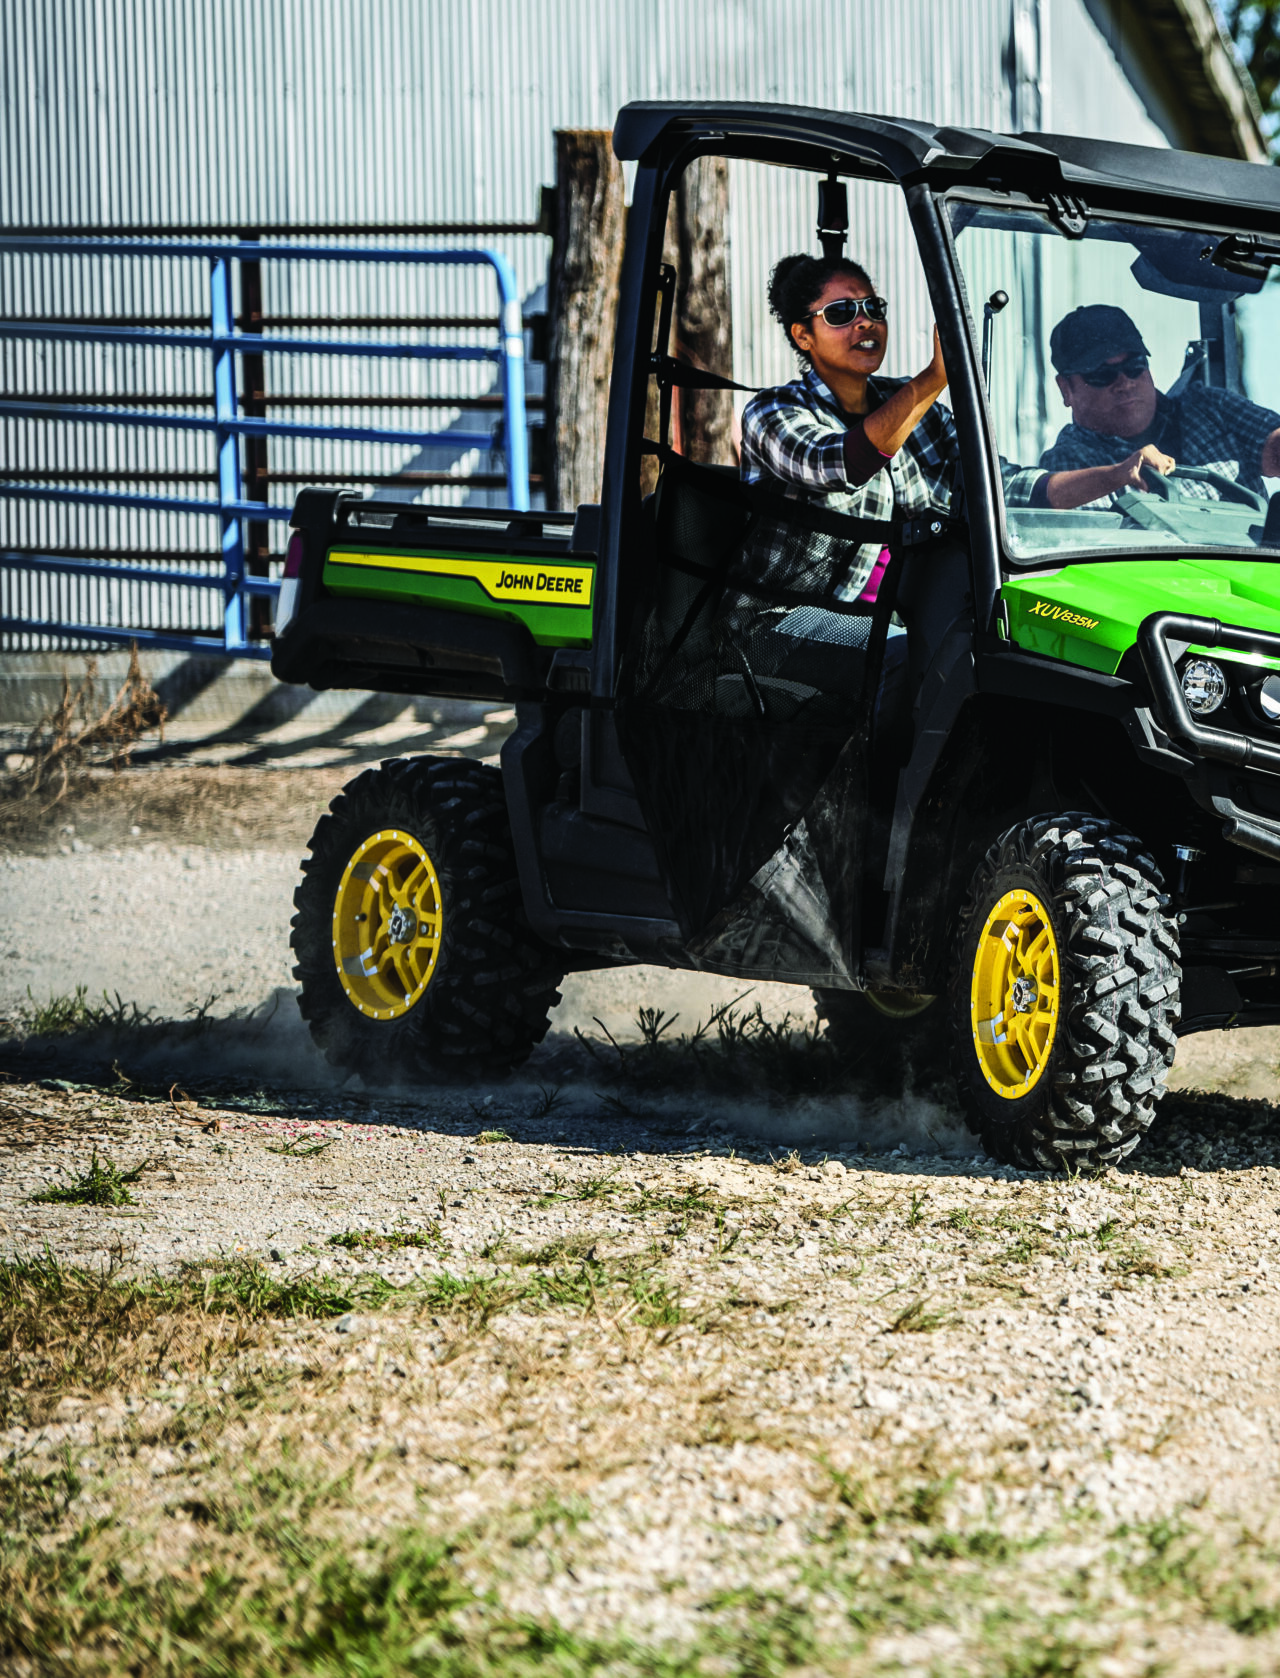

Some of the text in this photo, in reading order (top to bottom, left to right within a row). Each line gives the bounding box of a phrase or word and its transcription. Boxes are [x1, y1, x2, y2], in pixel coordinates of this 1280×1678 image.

[496, 570, 583, 593] JOHN DEERE
[1028, 601, 1099, 629] XUV835M
